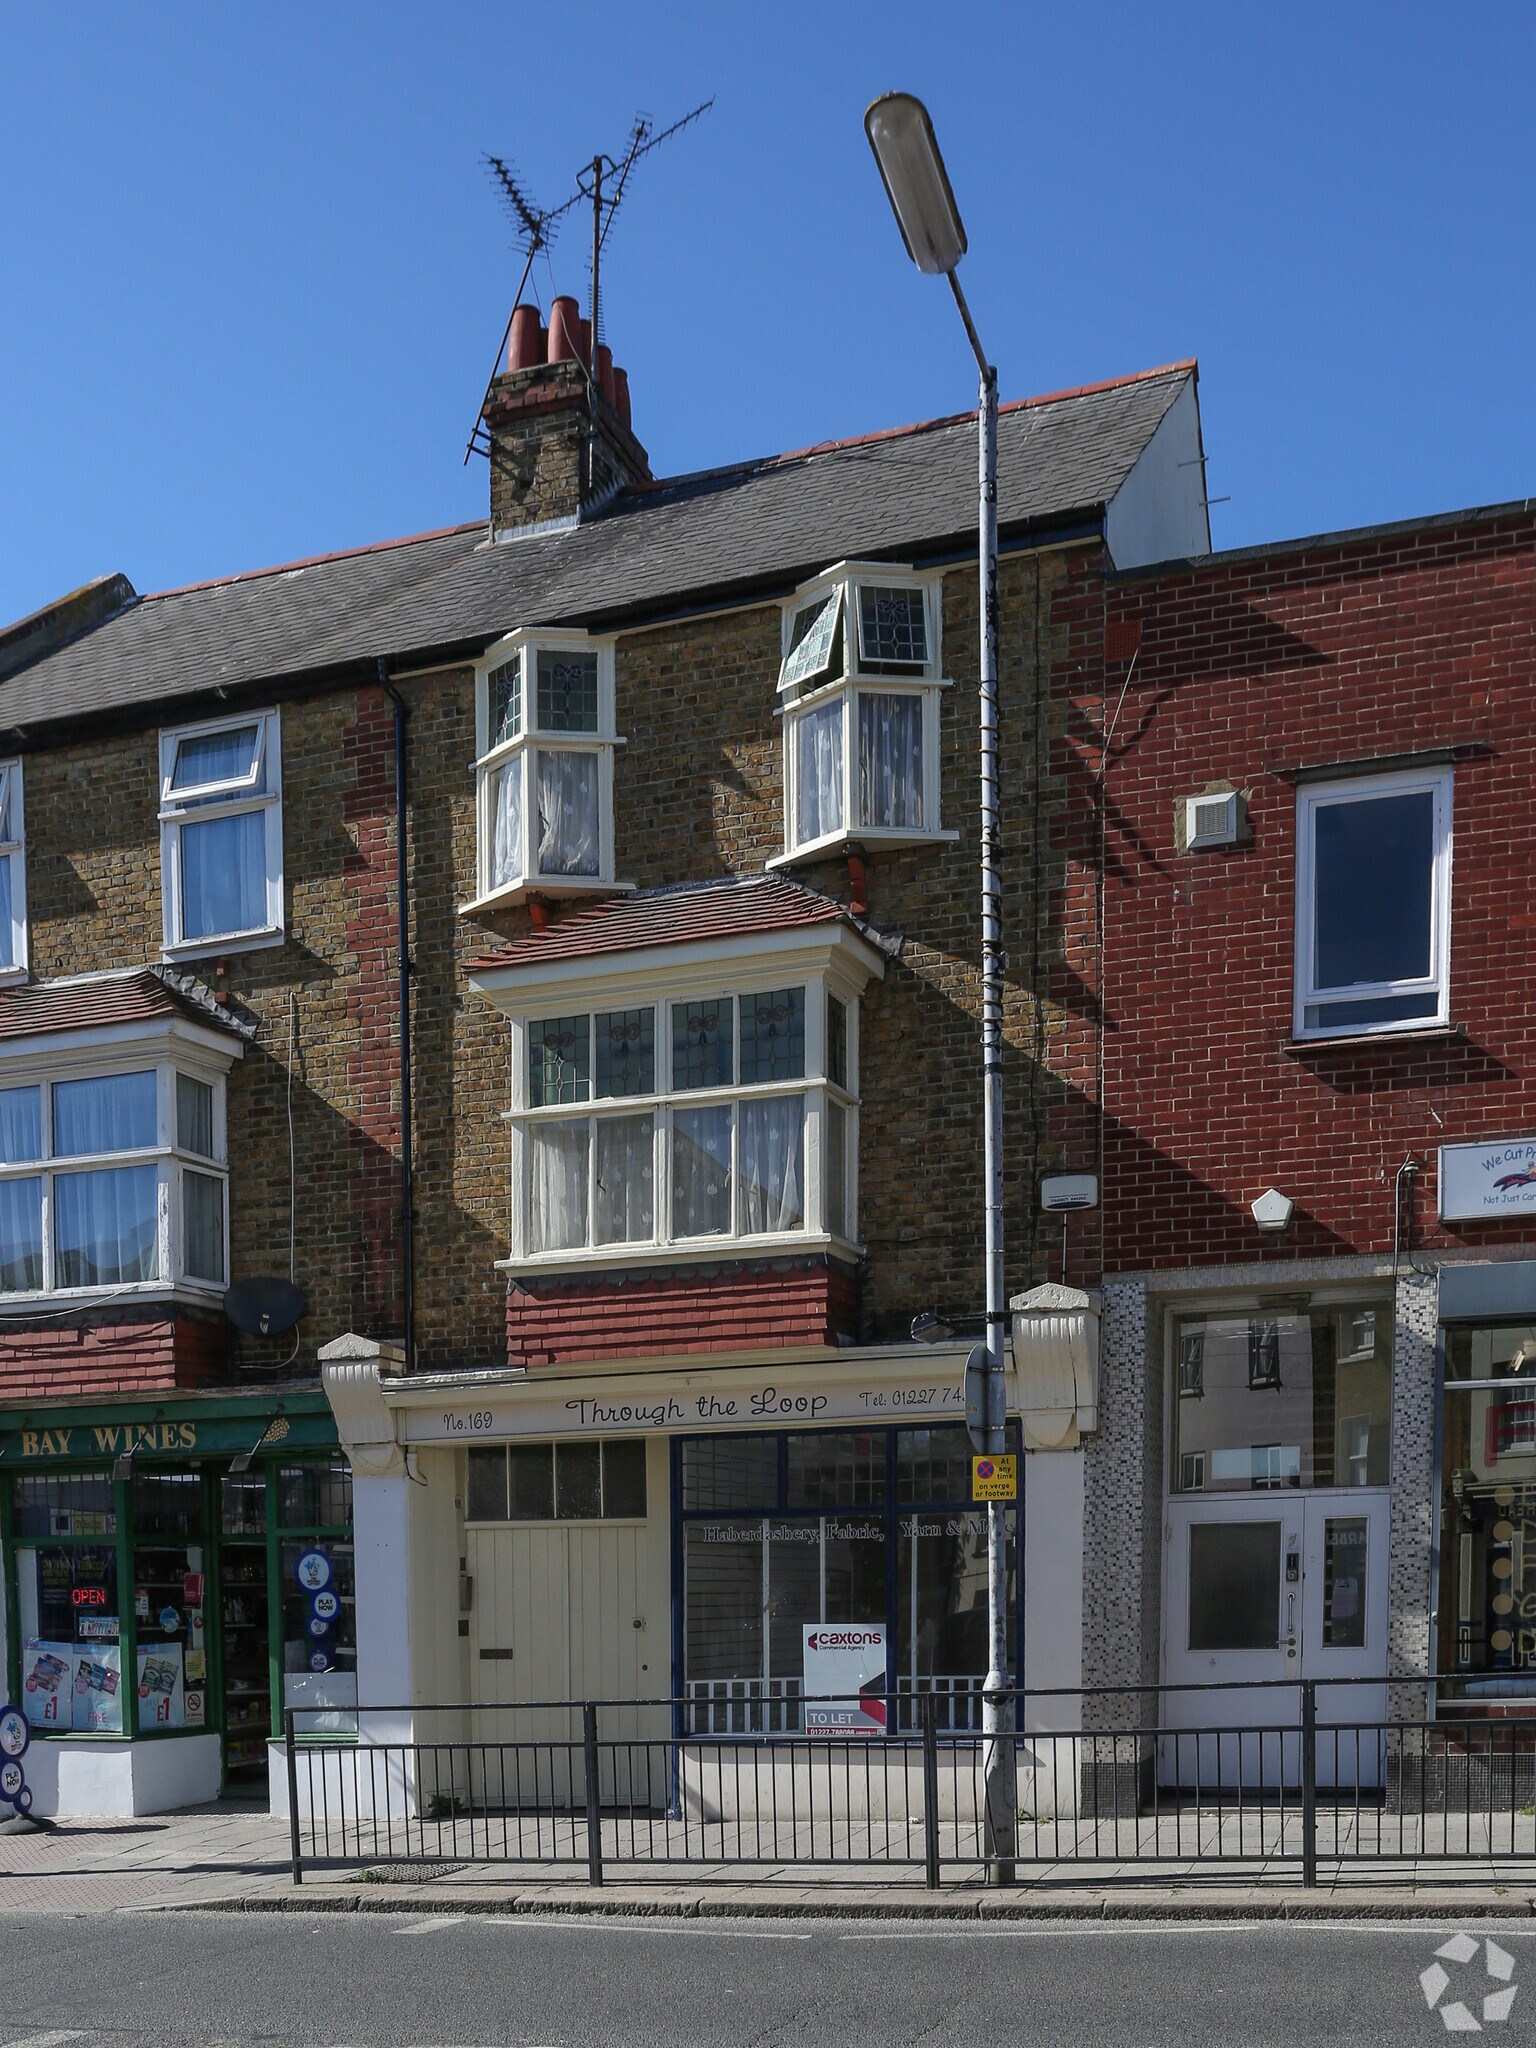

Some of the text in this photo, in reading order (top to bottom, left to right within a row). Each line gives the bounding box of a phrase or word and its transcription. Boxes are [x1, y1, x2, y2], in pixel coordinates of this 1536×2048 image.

[1482, 1156, 1502, 1171] We
[1504, 1148, 1523, 1161] Cut
[1484, 1196, 1499, 1204] Not
[1502, 1194, 1520, 1203] Just
[565, 1387, 828, 1425] Through the Loop
[858, 1387, 966, 1408] Tel: 01227 74
[21, 1422, 197, 1457] BAY WINES
[702, 1523, 885, 1545] Haberdashery, Fabric,
[900, 1518, 1014, 1537] Yarn & Me
[72, 1588, 105, 1605] OPEN
[819, 1631, 882, 1644] caxtons
[44, 1696, 58, 1720] £1
[87, 1711, 106, 1722] FREE
[157, 1697, 170, 1722] £1
[810, 1713, 853, 1724] TO LET
